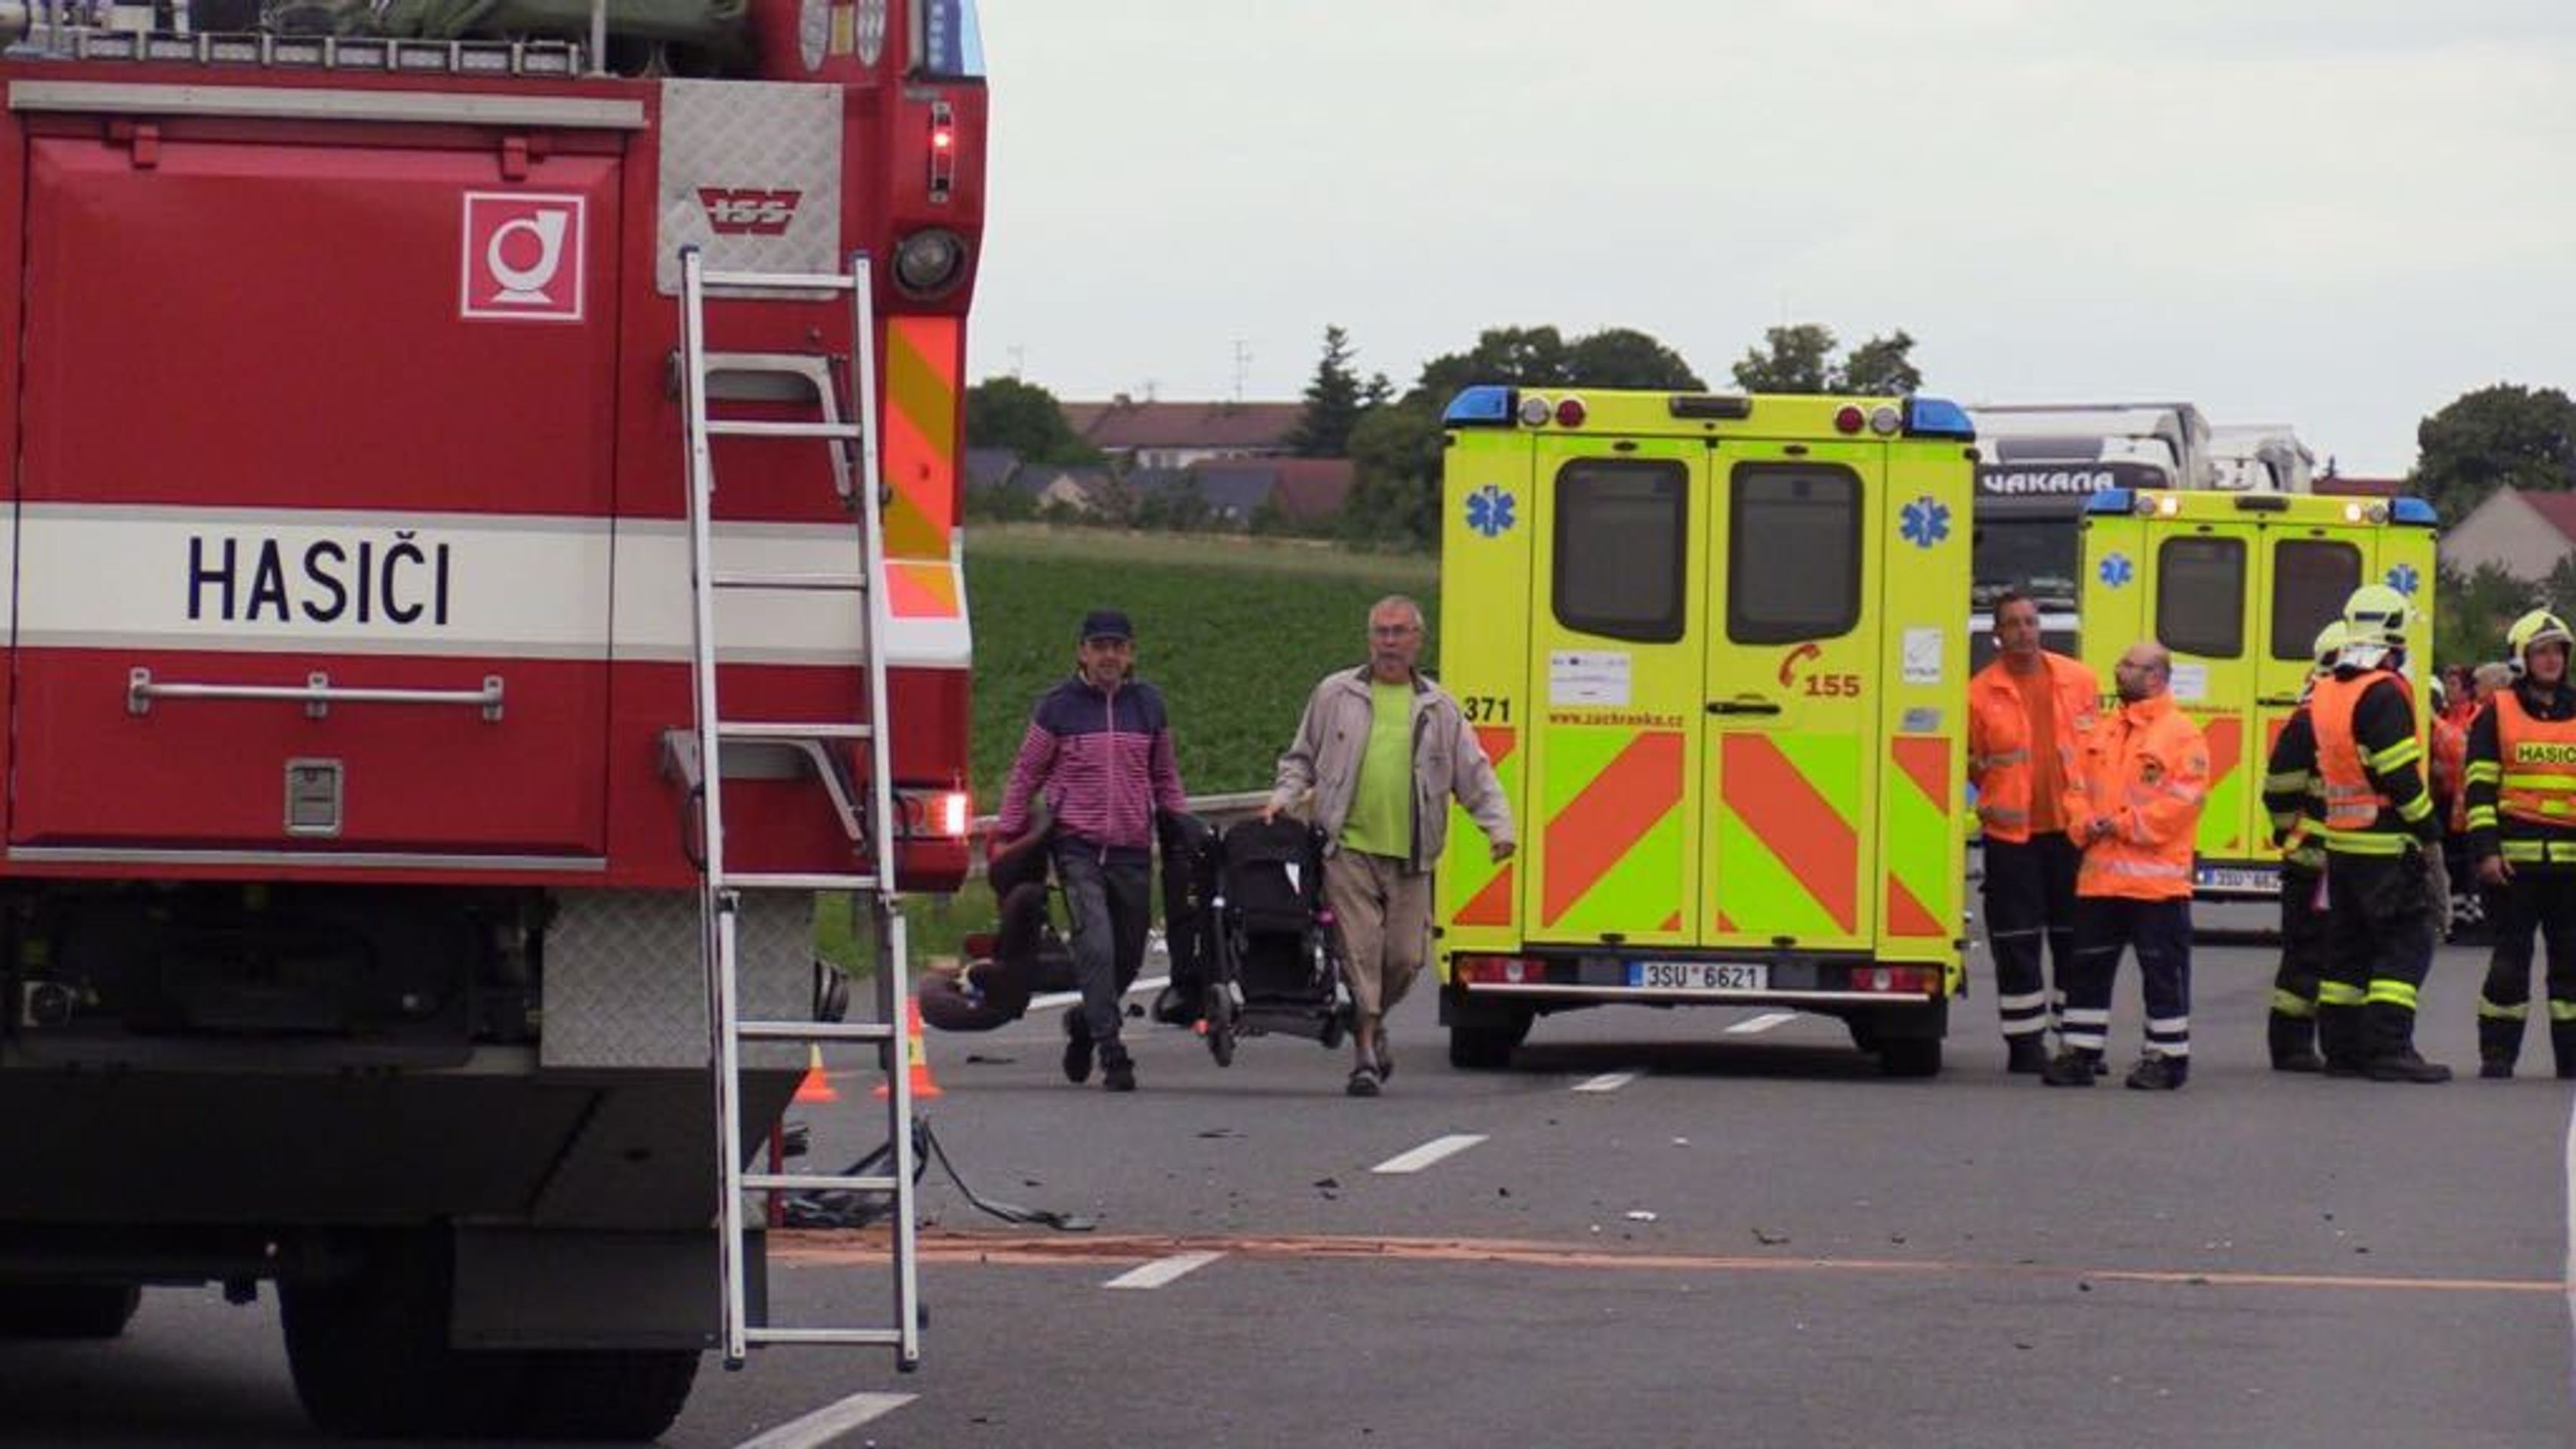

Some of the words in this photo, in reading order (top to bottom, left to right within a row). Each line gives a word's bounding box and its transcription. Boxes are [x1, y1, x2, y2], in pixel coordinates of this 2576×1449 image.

[188, 530, 450, 626] HASIČI
[1805, 674, 1861, 697] 155
[1463, 696, 1510, 722] 371
[1550, 712, 1684, 728] www.zachranka.cz
[1647, 965, 1687, 987] 3SU
[1703, 967, 1756, 989] 6621
